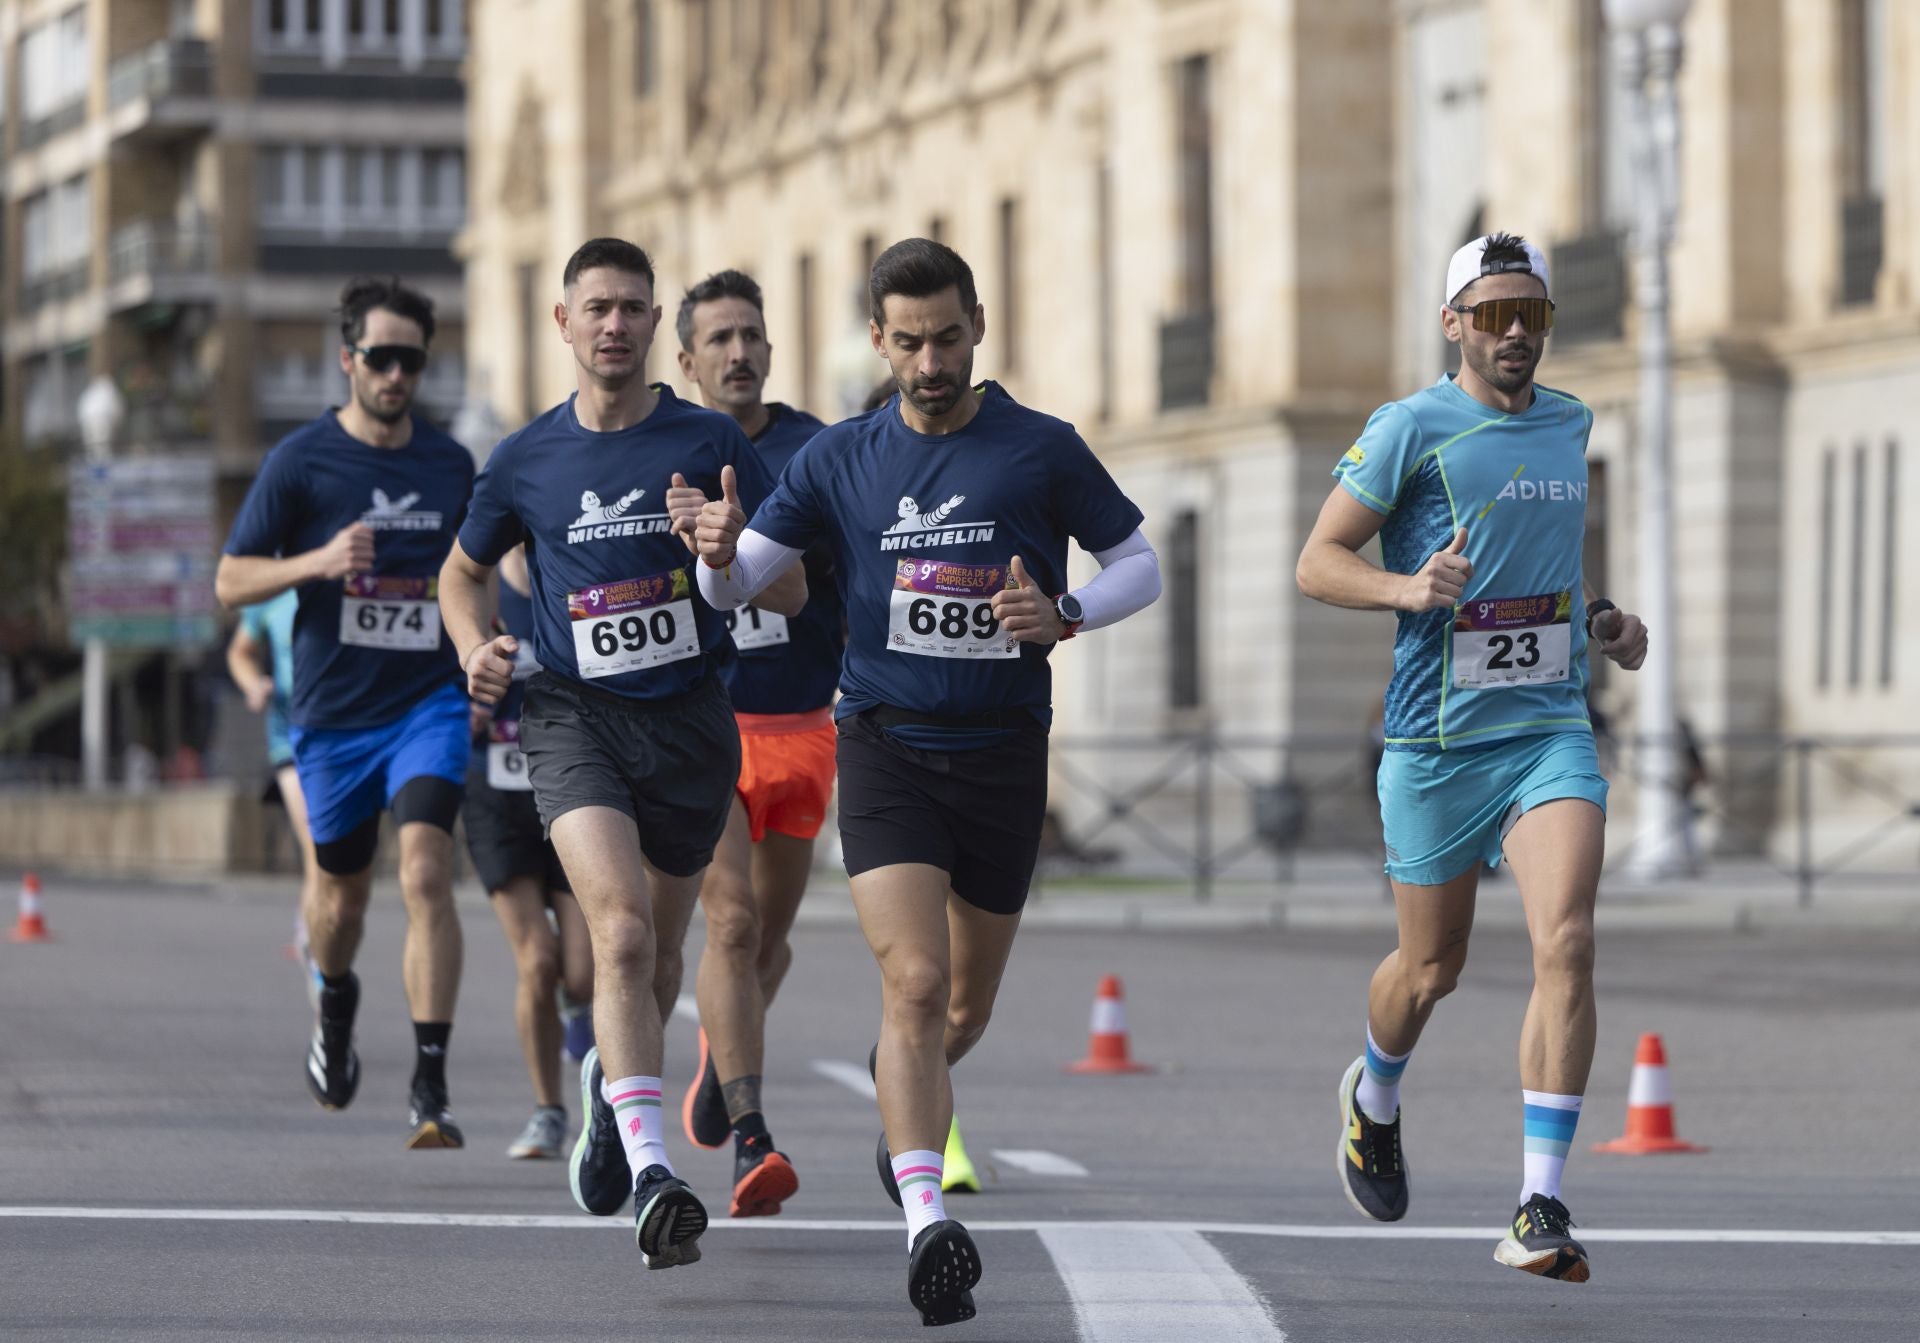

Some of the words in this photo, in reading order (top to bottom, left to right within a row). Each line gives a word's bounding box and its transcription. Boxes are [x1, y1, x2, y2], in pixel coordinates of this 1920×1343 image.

[567, 519, 671, 545] MICHELIN
[880, 528, 995, 551] MICHELIN
[921, 564, 937, 581] 9ª
[937, 565, 973, 578] CARRERA
[975, 568, 985, 578] DE
[936, 574, 985, 588] EMPRESAS
[588, 588, 604, 607] 9ª
[604, 581, 638, 595] CARRERA
[640, 579, 650, 589] DE
[605, 589, 652, 605] EMPRESAS
[356, 604, 424, 634] 674
[908, 598, 1000, 640] 689
[1478, 602, 1494, 620] 9ª
[1495, 600, 1527, 610] CARRERA
[1528, 598, 1537, 608] DE
[1495, 606, 1537, 620] EMPRESAS
[591, 609, 677, 657] 690
[1486, 632, 1541, 670] 23
